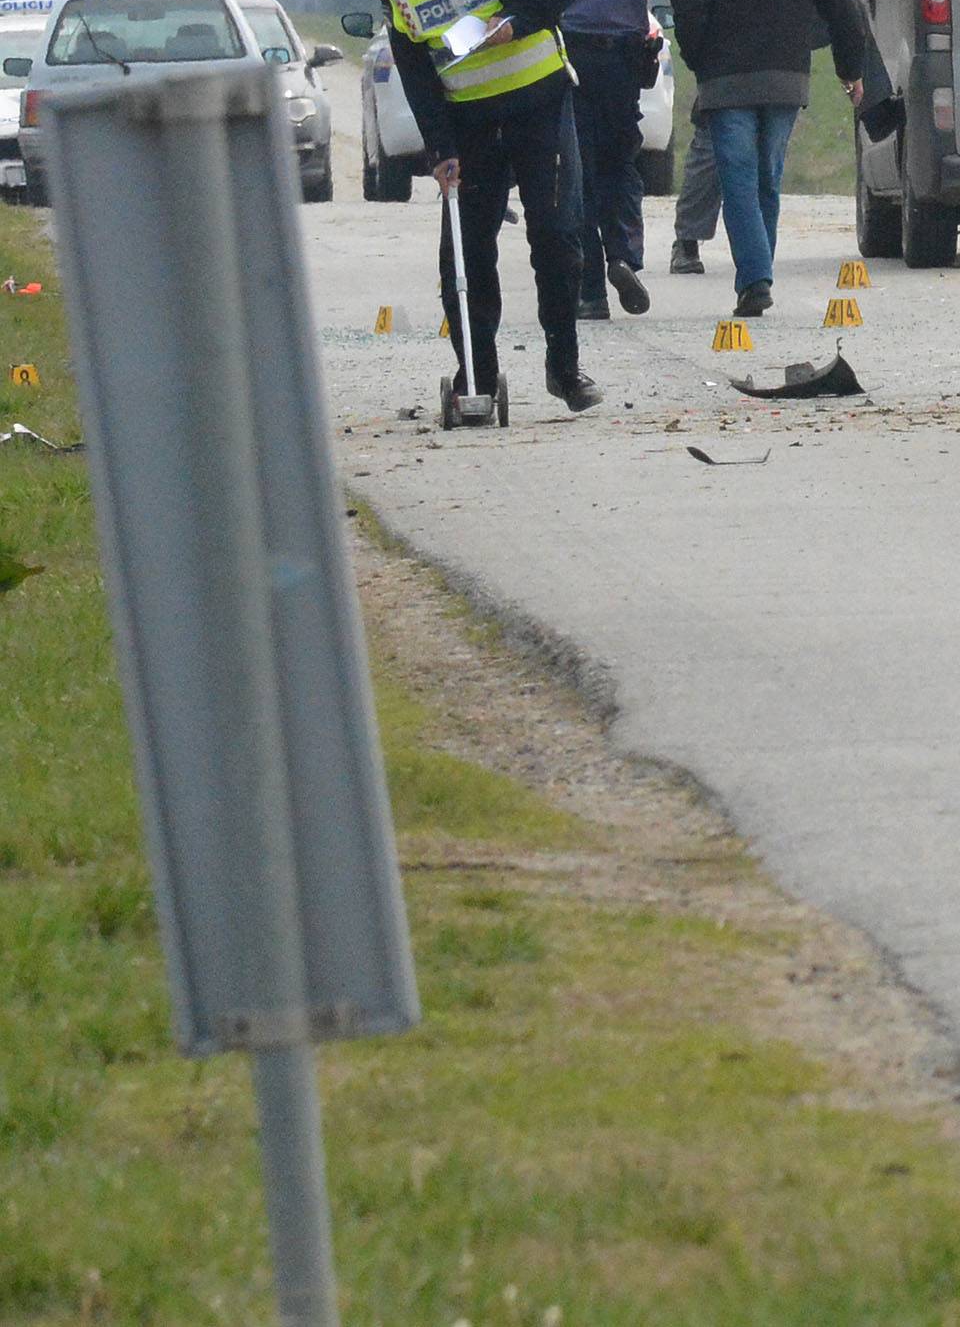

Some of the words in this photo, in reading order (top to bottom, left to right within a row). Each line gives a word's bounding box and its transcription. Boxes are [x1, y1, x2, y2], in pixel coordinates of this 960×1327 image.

[0, 0, 54, 11] OLICIJ
[856, 263, 865, 286] 2
[846, 302, 856, 321] 4
[720, 325, 728, 348] 7
[734, 324, 743, 347] 7
